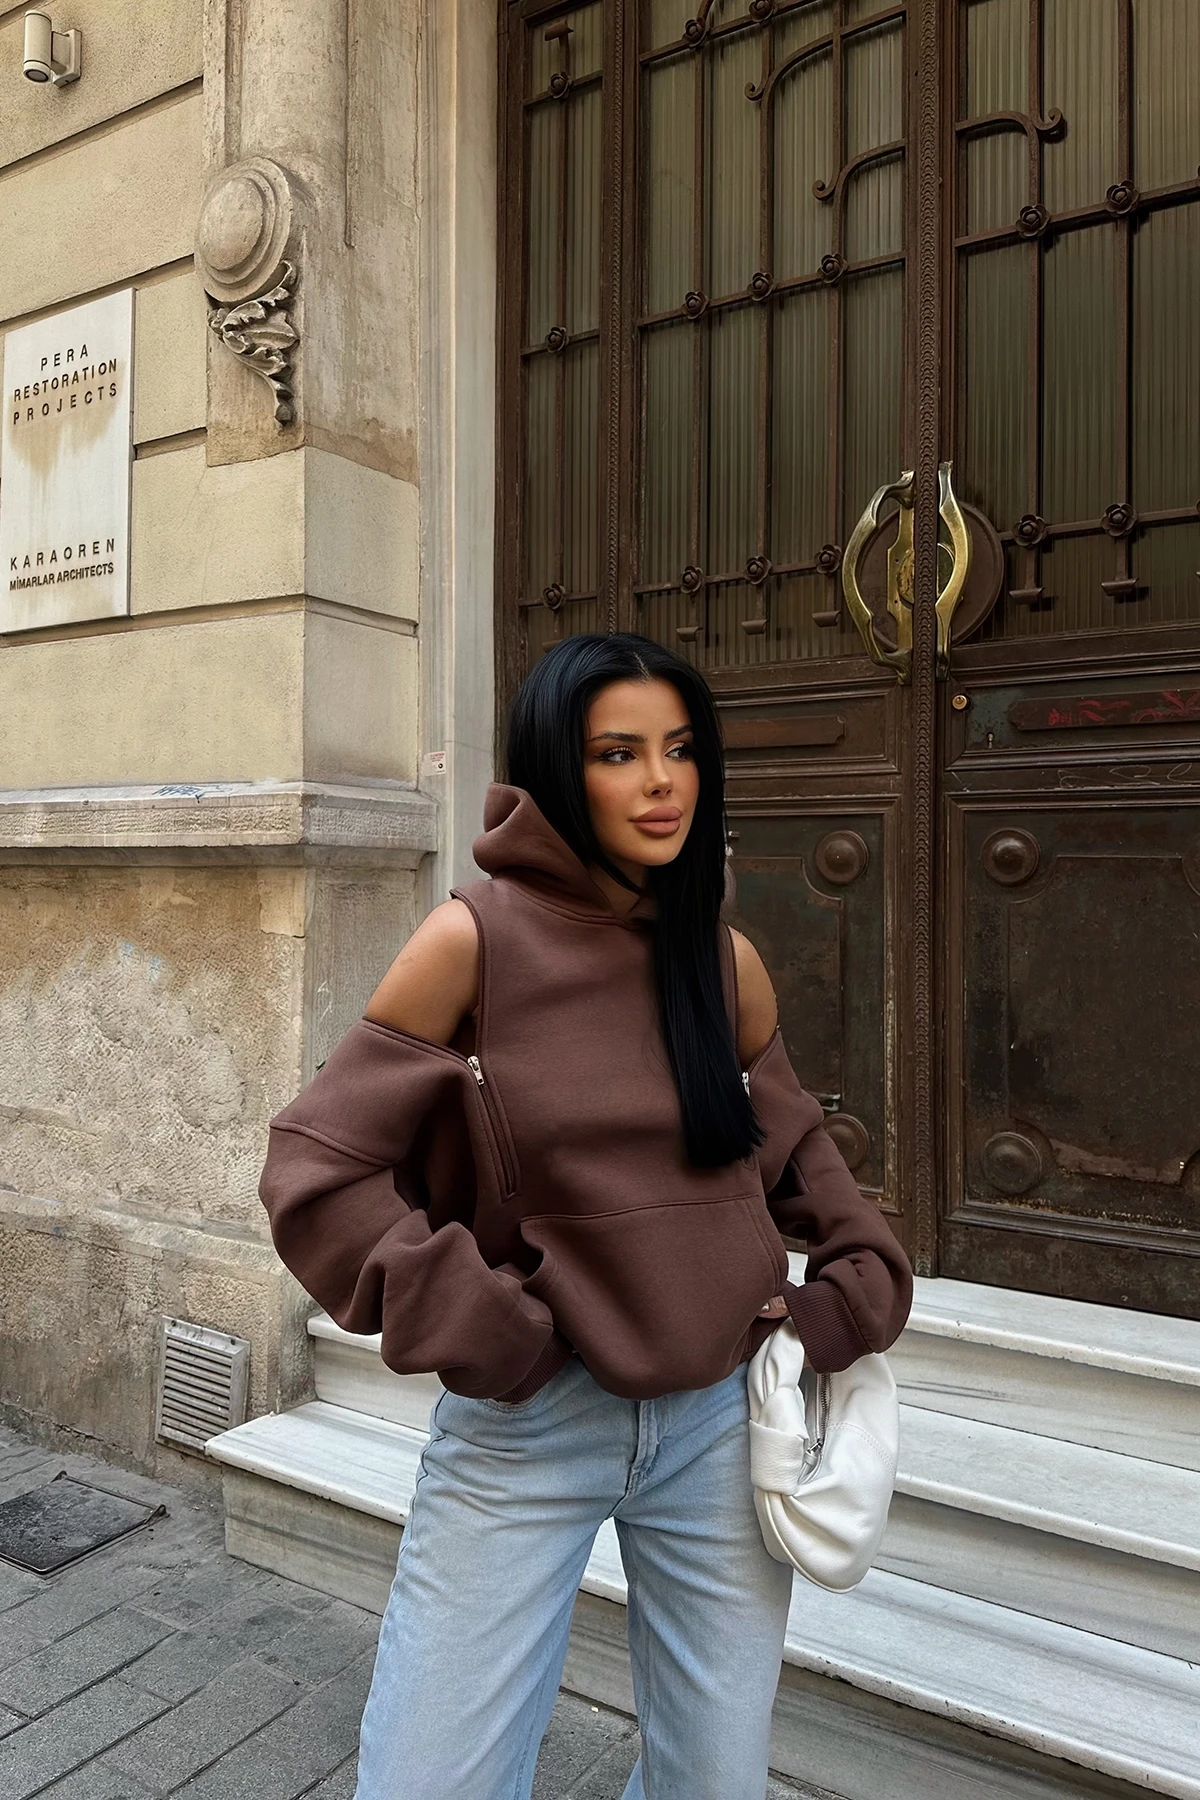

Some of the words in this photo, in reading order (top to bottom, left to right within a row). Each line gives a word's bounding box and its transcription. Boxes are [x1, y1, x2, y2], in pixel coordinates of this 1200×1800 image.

[40, 344, 88, 371] PERA
[14, 358, 117, 402] RESTORATION
[13, 382, 117, 425] PROJECTS
[10, 538, 115, 571] KARAOREN
[56, 562, 114, 584] ARCHITECTS
